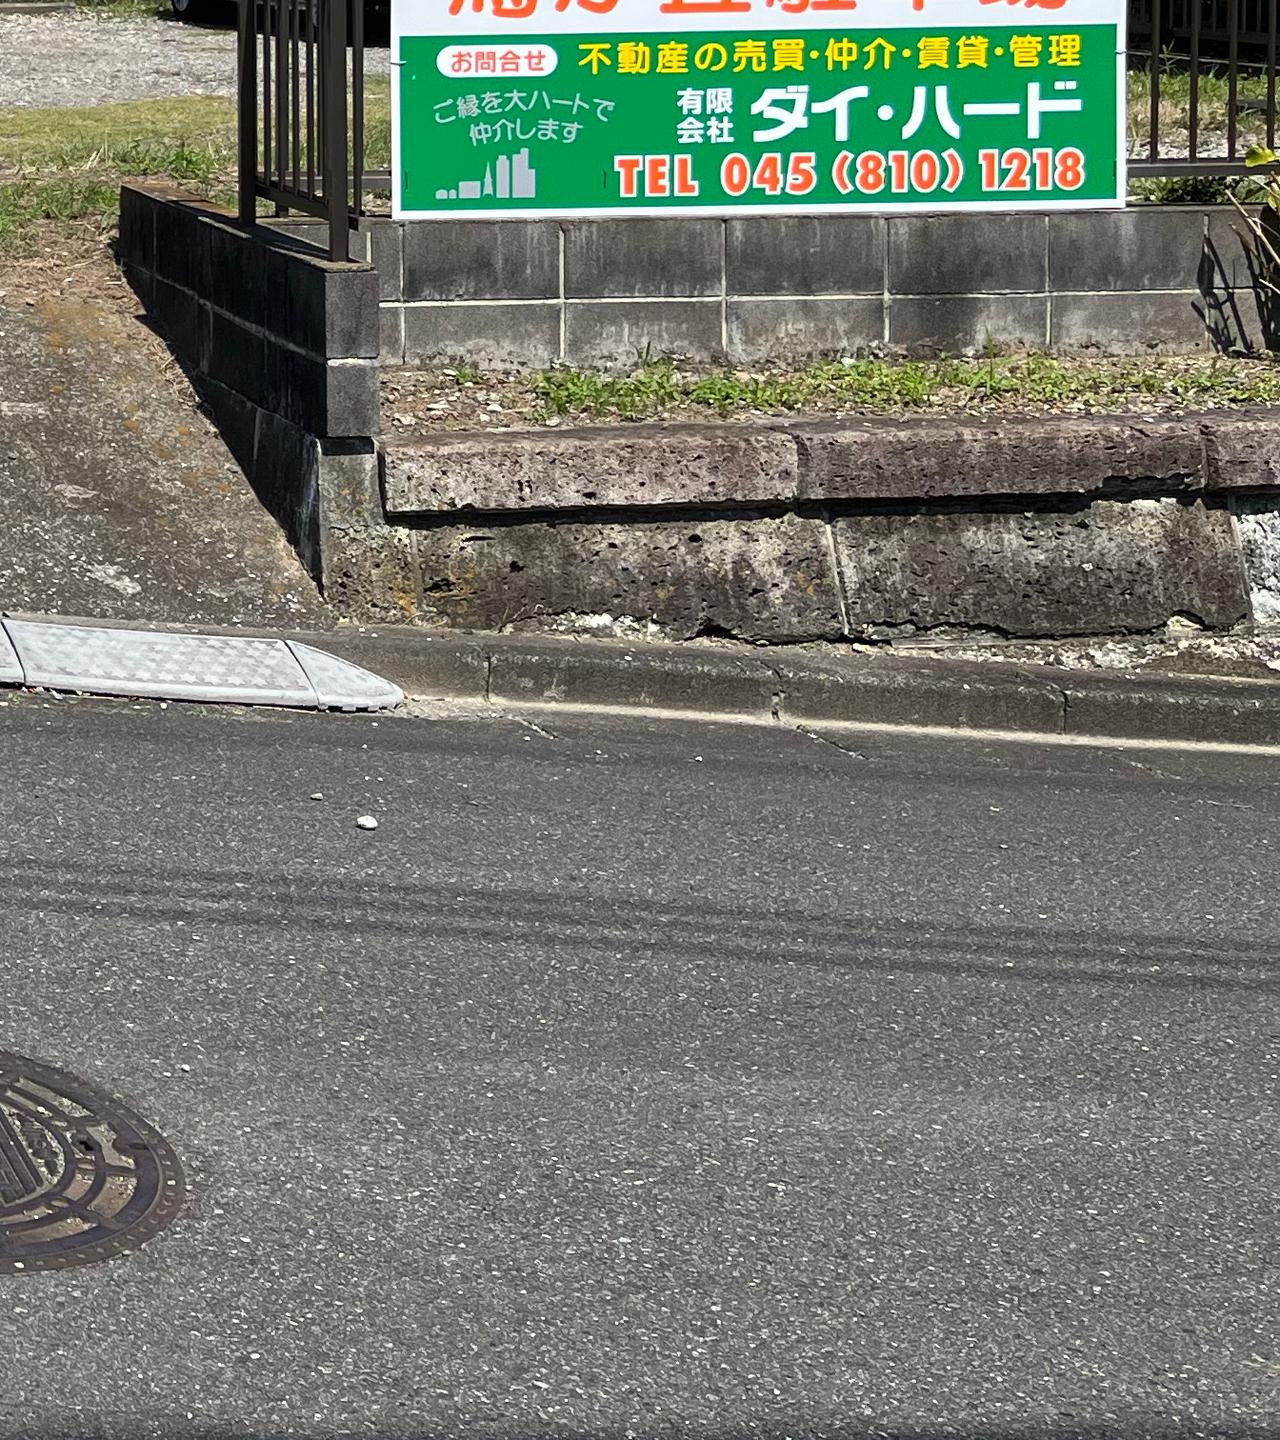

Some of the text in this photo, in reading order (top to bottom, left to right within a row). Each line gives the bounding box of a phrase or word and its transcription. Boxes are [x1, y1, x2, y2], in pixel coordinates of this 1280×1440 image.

[451, 50, 546, 73] お問合せ
[578, 34, 1082, 75] 不動産の売買・仲介・賃貸・管理
[433, 88, 615, 124] ご縁を大ハートで
[677, 87, 733, 115] 有限
[750, 80, 1082, 143] ダイ・ハード
[469, 117, 584, 146] 仲介します
[677, 116, 734, 144] 会社
[615, 147, 1085, 197] TEL 045 (810) 1218
